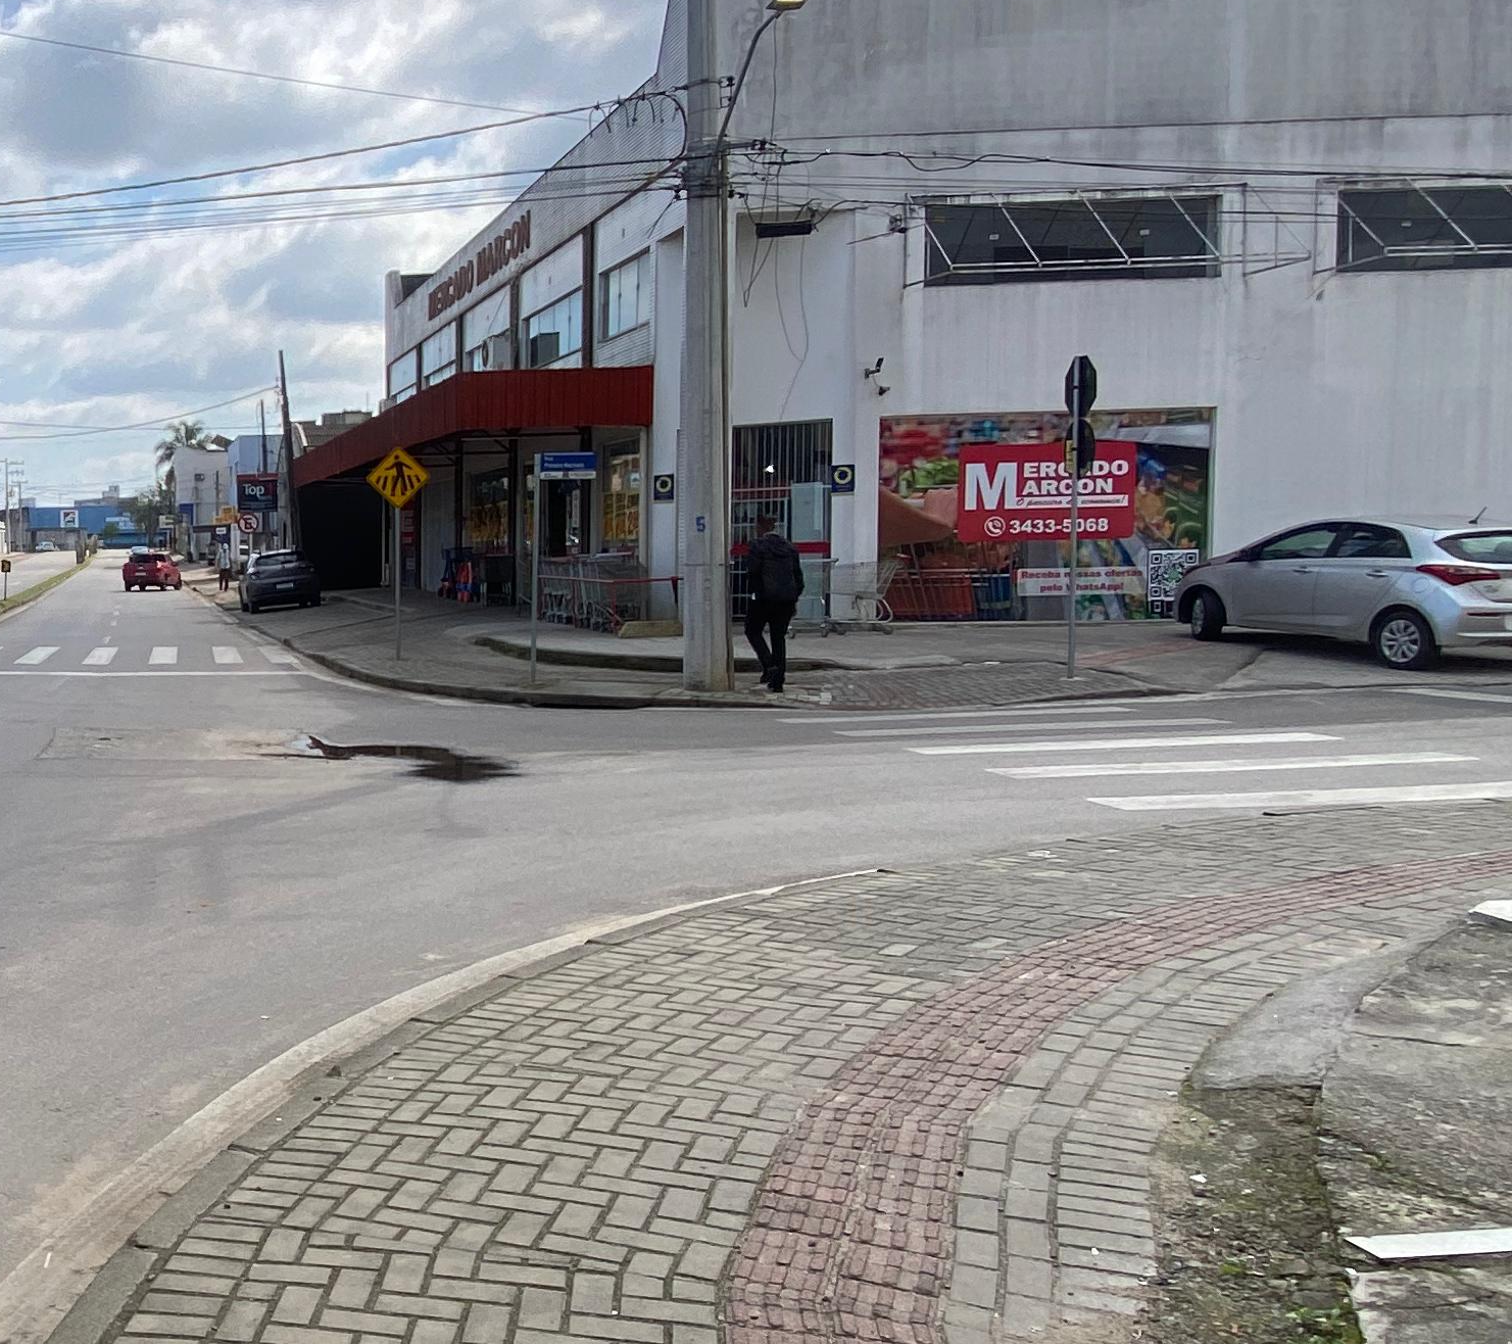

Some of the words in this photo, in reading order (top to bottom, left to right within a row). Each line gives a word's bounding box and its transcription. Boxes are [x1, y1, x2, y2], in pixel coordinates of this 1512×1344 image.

[428, 259, 474, 321] MERCADO
[476, 209, 531, 286] MARCON
[243, 483, 265, 500] Top
[696, 516, 705, 532] 5
[1009, 518, 1109, 534] 3433-5068
[1021, 571, 1060, 579] Receba
[1064, 570, 1101, 578] nssas
[1104, 568, 1143, 578] ofertas
[1039, 584, 1063, 592] pelo
